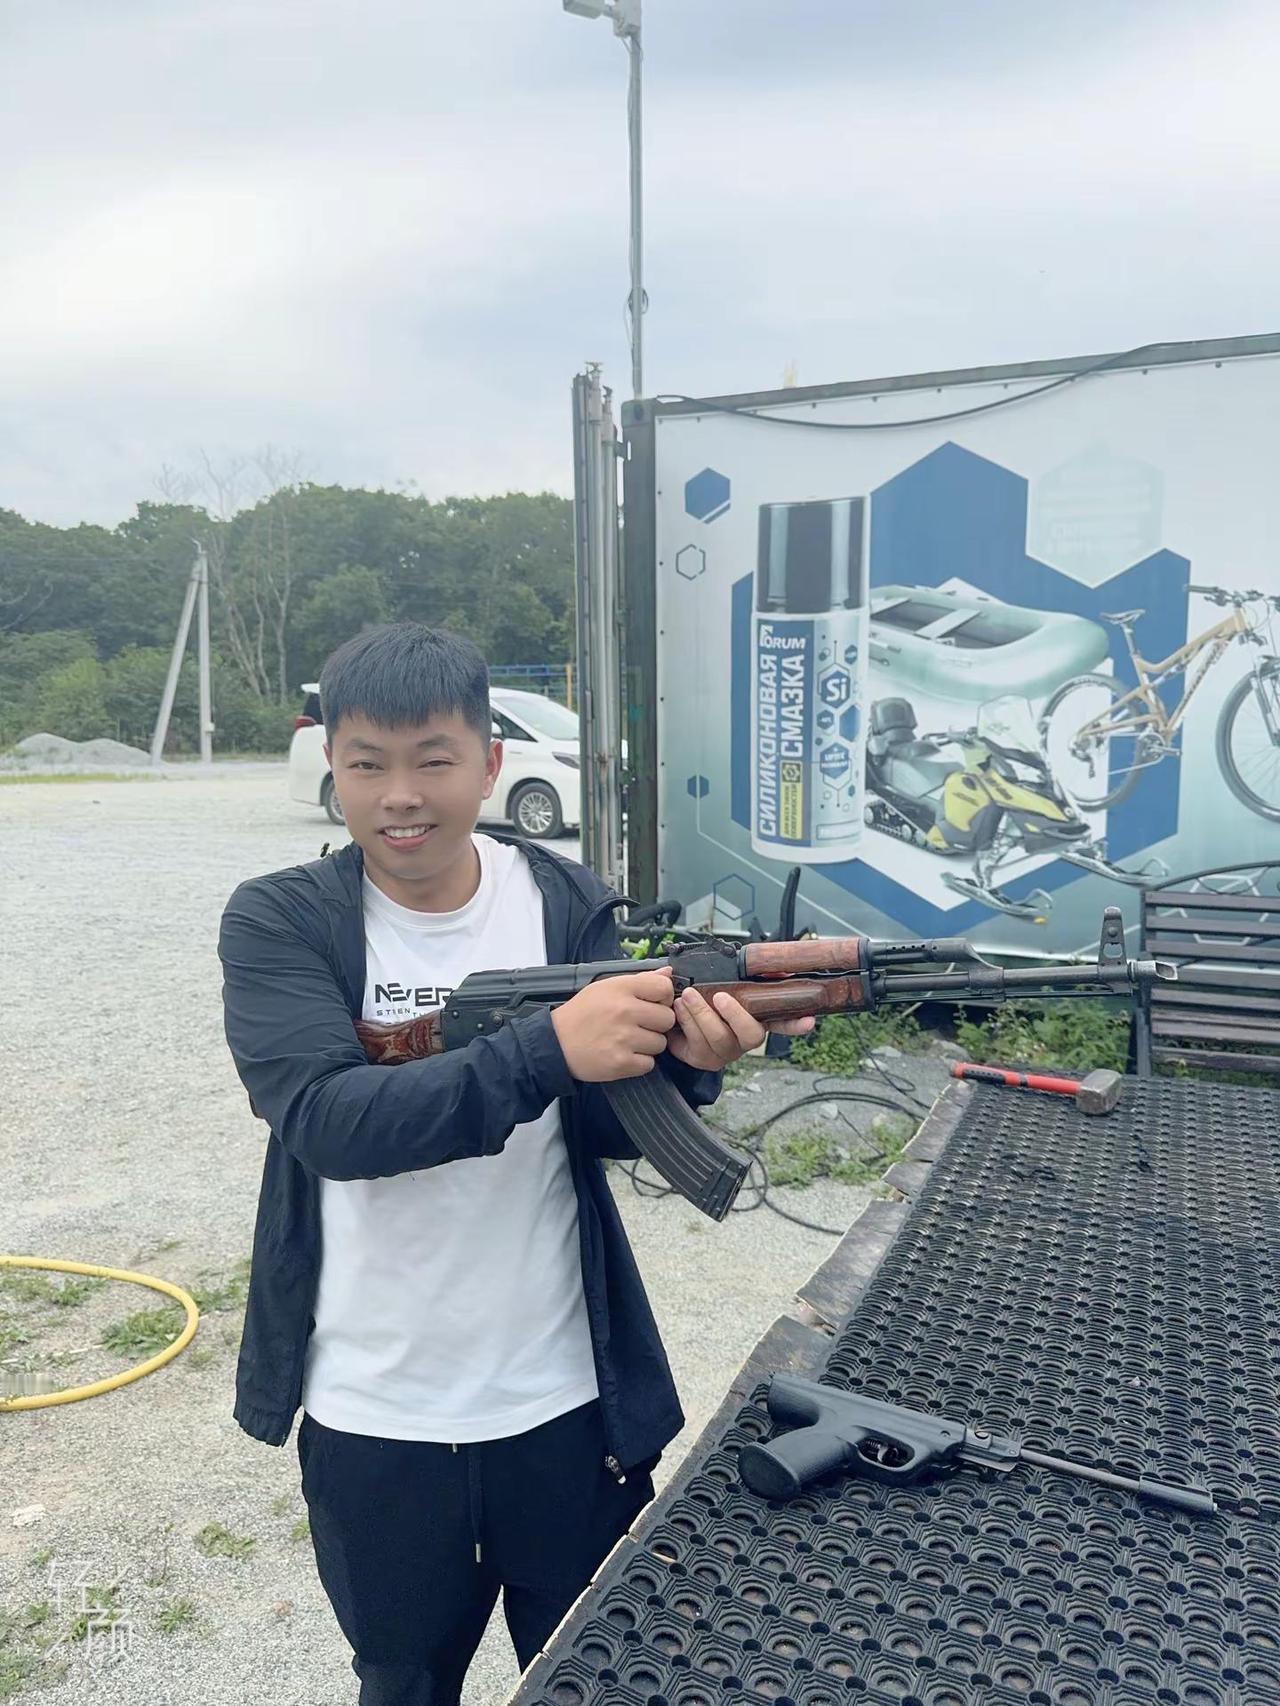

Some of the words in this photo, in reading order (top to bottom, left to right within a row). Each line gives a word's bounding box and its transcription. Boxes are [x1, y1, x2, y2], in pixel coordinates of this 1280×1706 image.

[760, 624, 806, 650] FORUM
[781, 654, 805, 758] СМАЗКА
[826, 678, 847, 702] Si
[759, 654, 777, 836] СИЛИКОНОВАЯ
